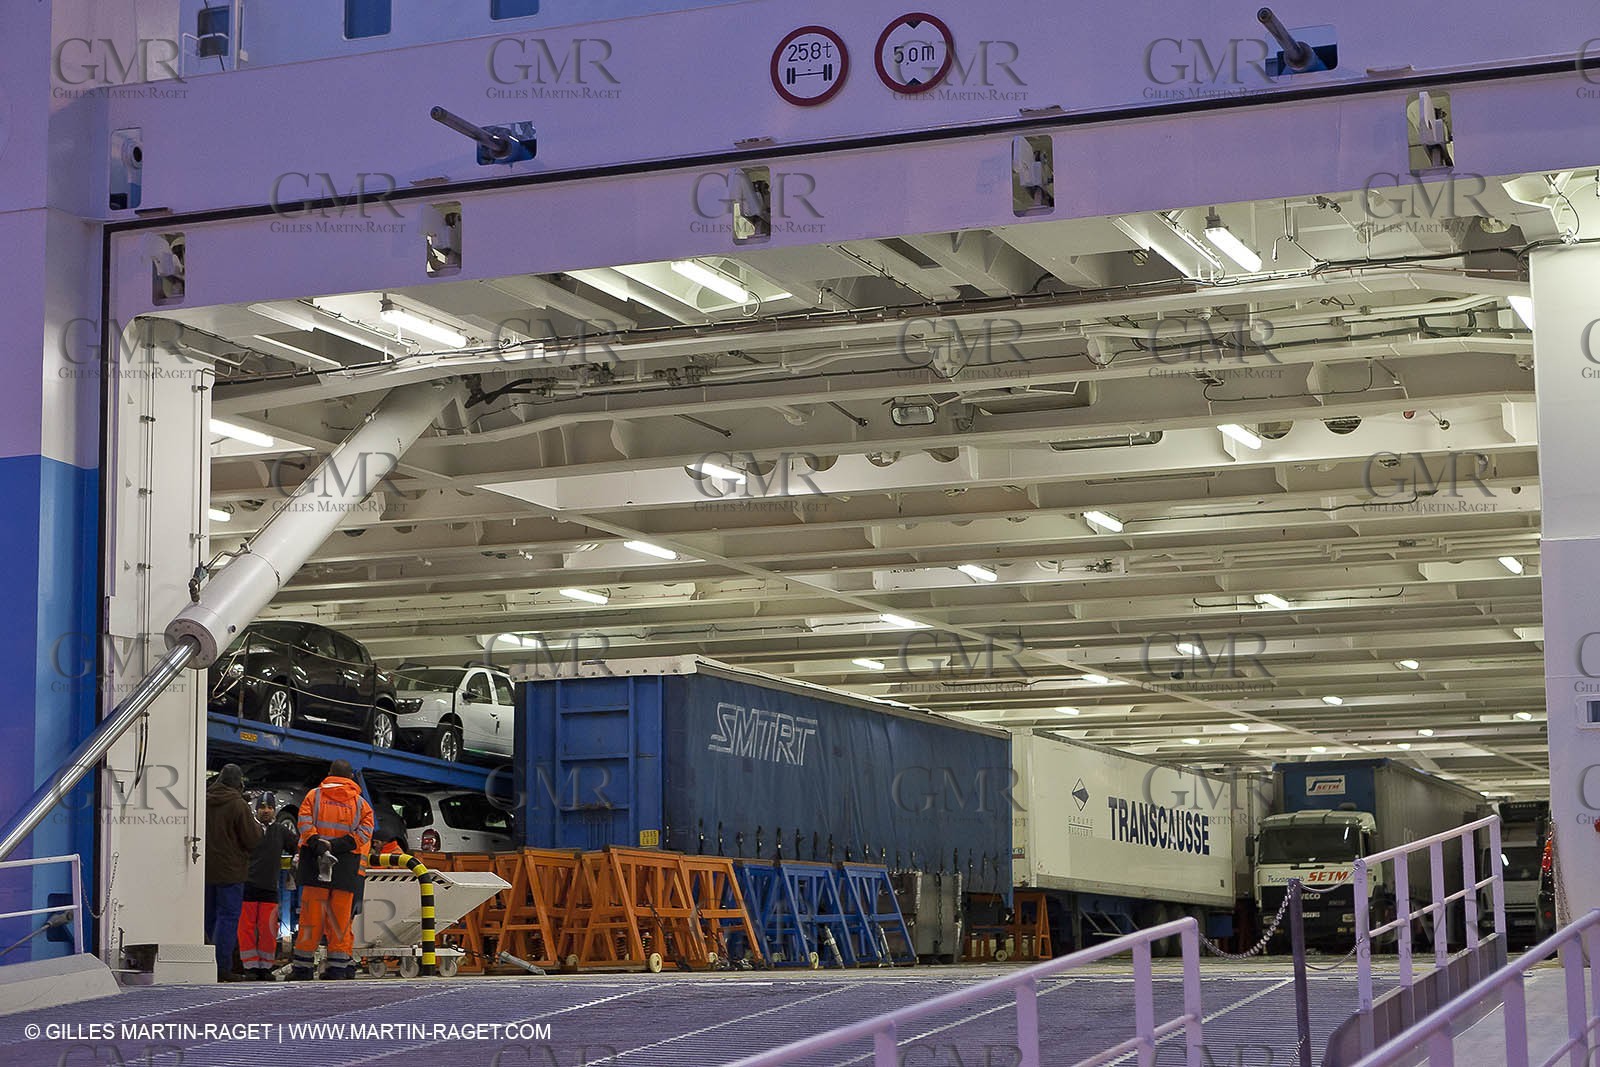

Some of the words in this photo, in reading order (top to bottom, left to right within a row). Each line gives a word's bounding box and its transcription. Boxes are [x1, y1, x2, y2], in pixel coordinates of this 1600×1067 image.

[708, 702, 818, 766] SMTRT
[1108, 796, 1210, 856] TRANSCAUSSE
[1308, 871, 1349, 882] SETM
[1300, 892, 1321, 900] VECO
